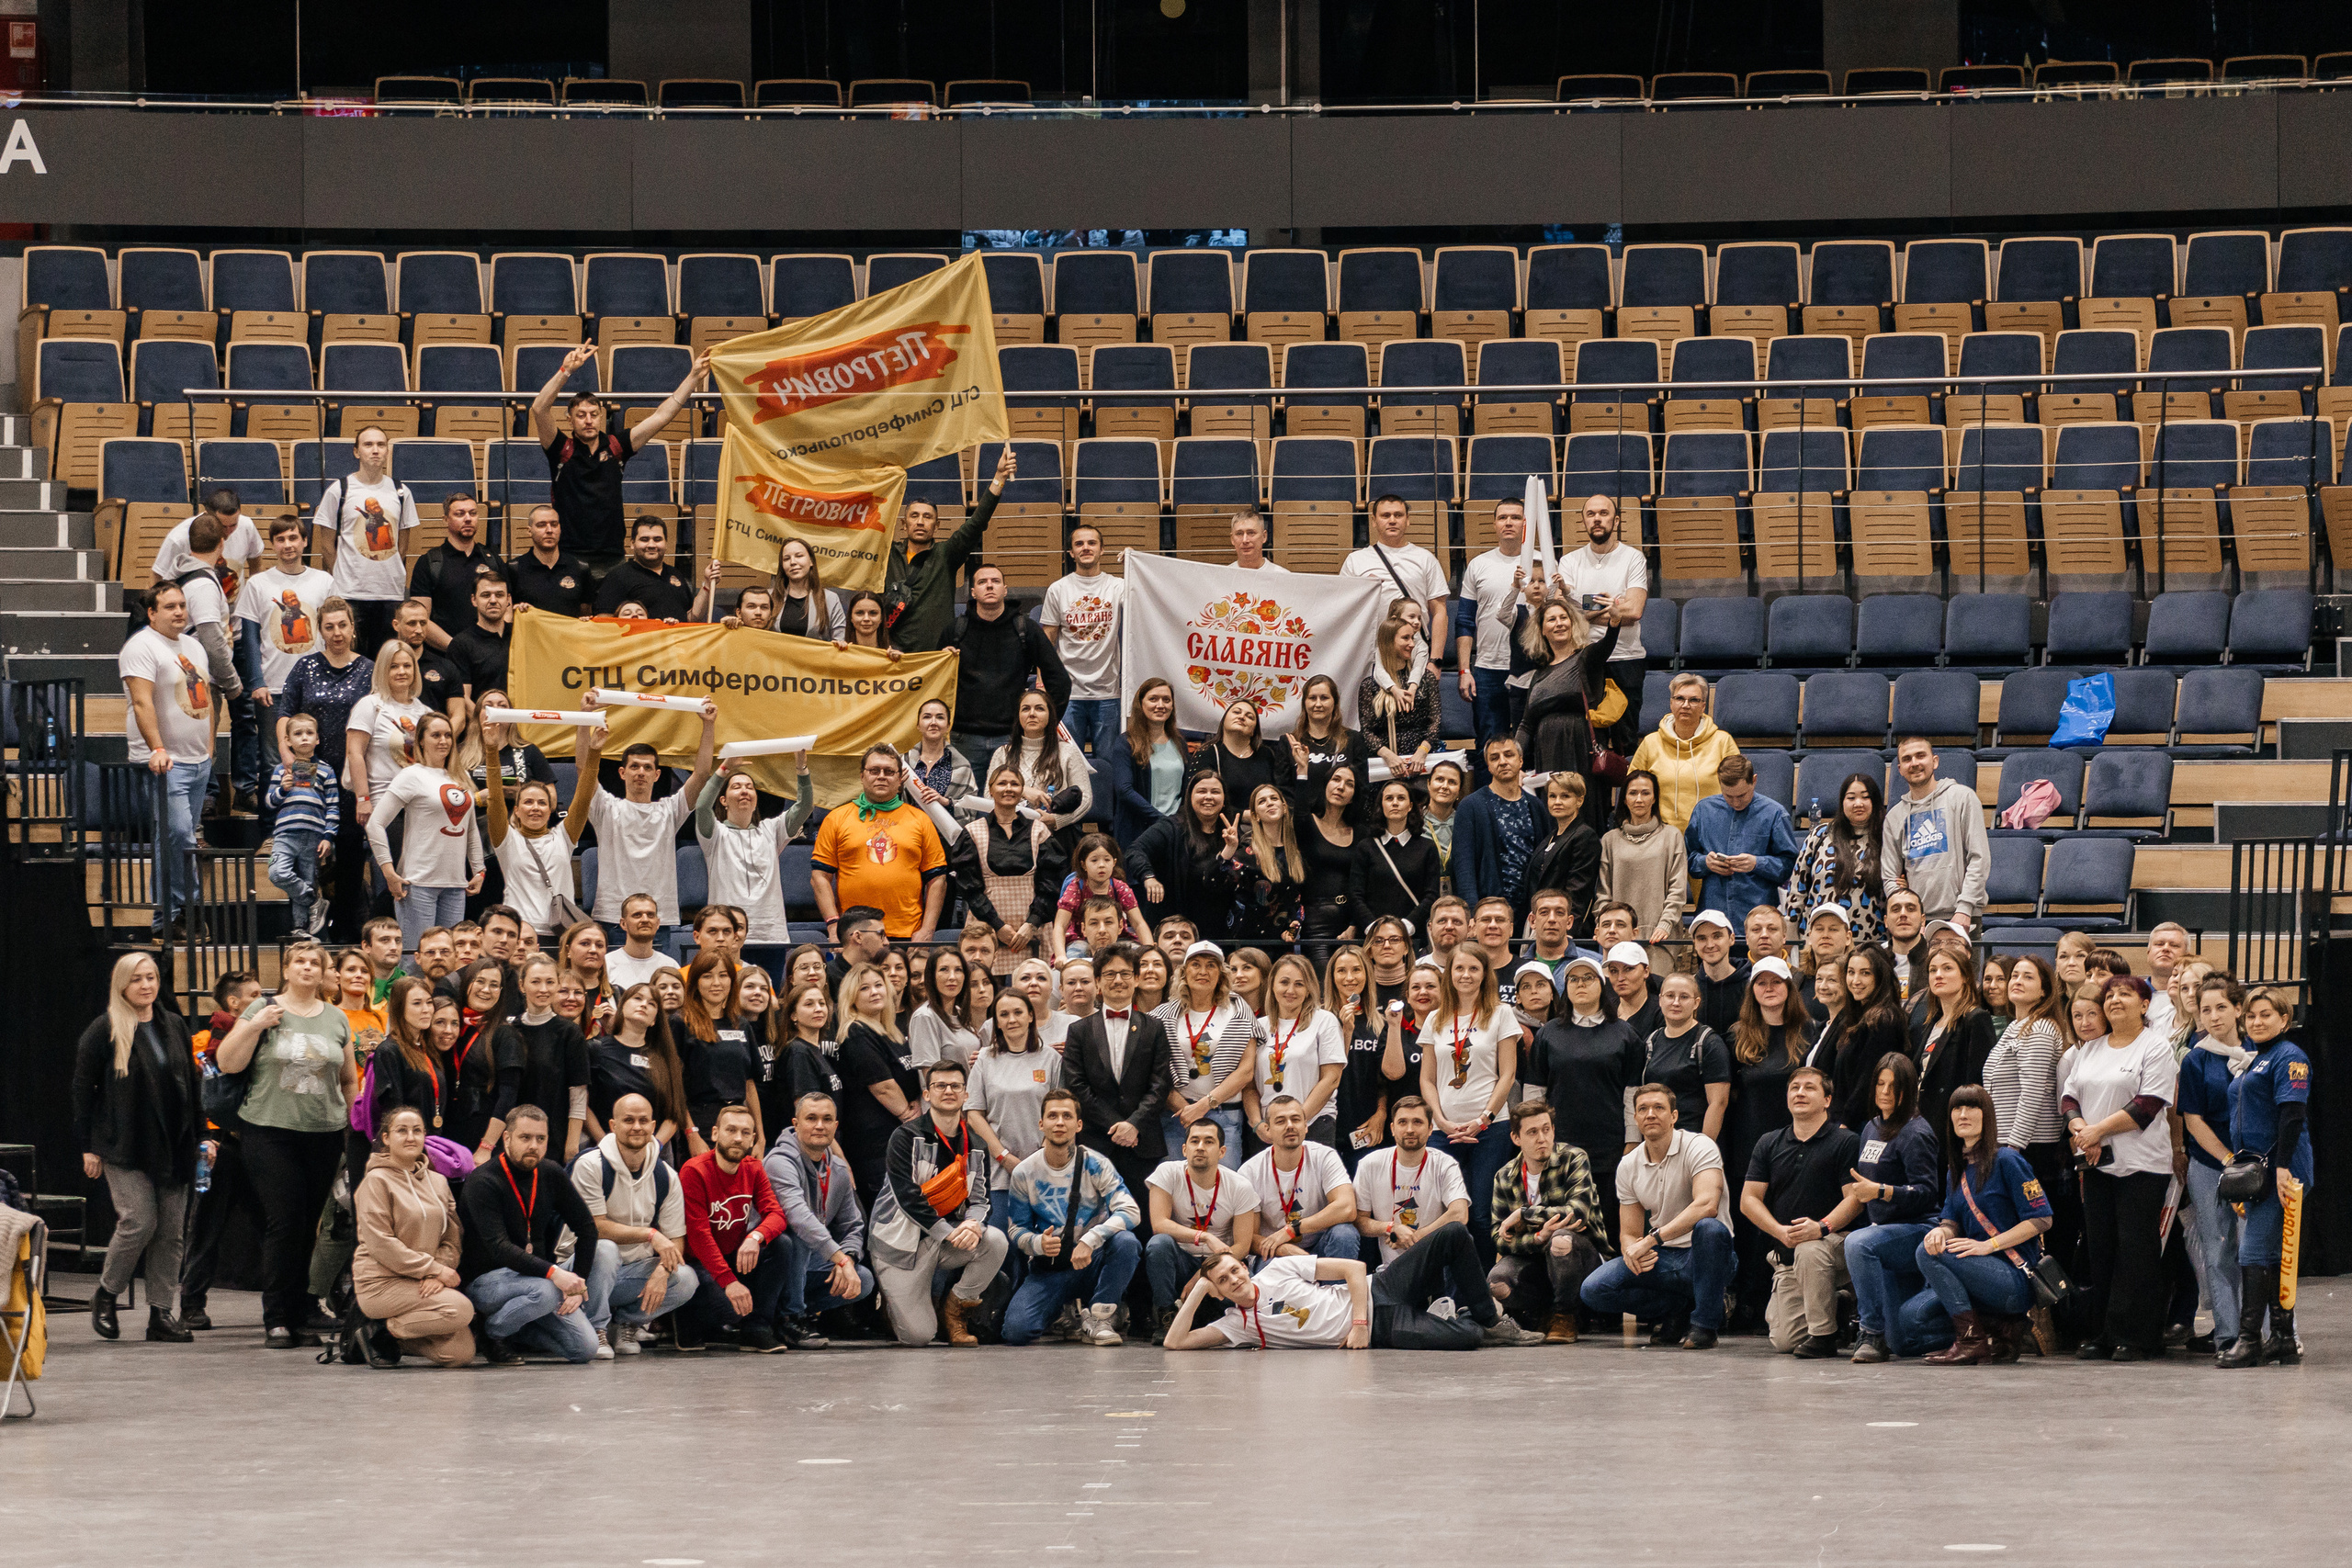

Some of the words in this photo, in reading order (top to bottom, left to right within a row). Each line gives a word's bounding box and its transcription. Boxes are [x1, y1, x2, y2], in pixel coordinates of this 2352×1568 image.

[726, 518, 751, 537] СТЦ
[755, 527, 879, 562] Симопольское
[1066, 610, 1114, 625] СЛАВЯНЕ
[1186, 632, 1312, 671] СЛАВЯНЕ
[561, 665, 626, 692] СТЦ
[637, 664, 923, 695] Симферопольское
[1910, 829, 1944, 848] adidas
